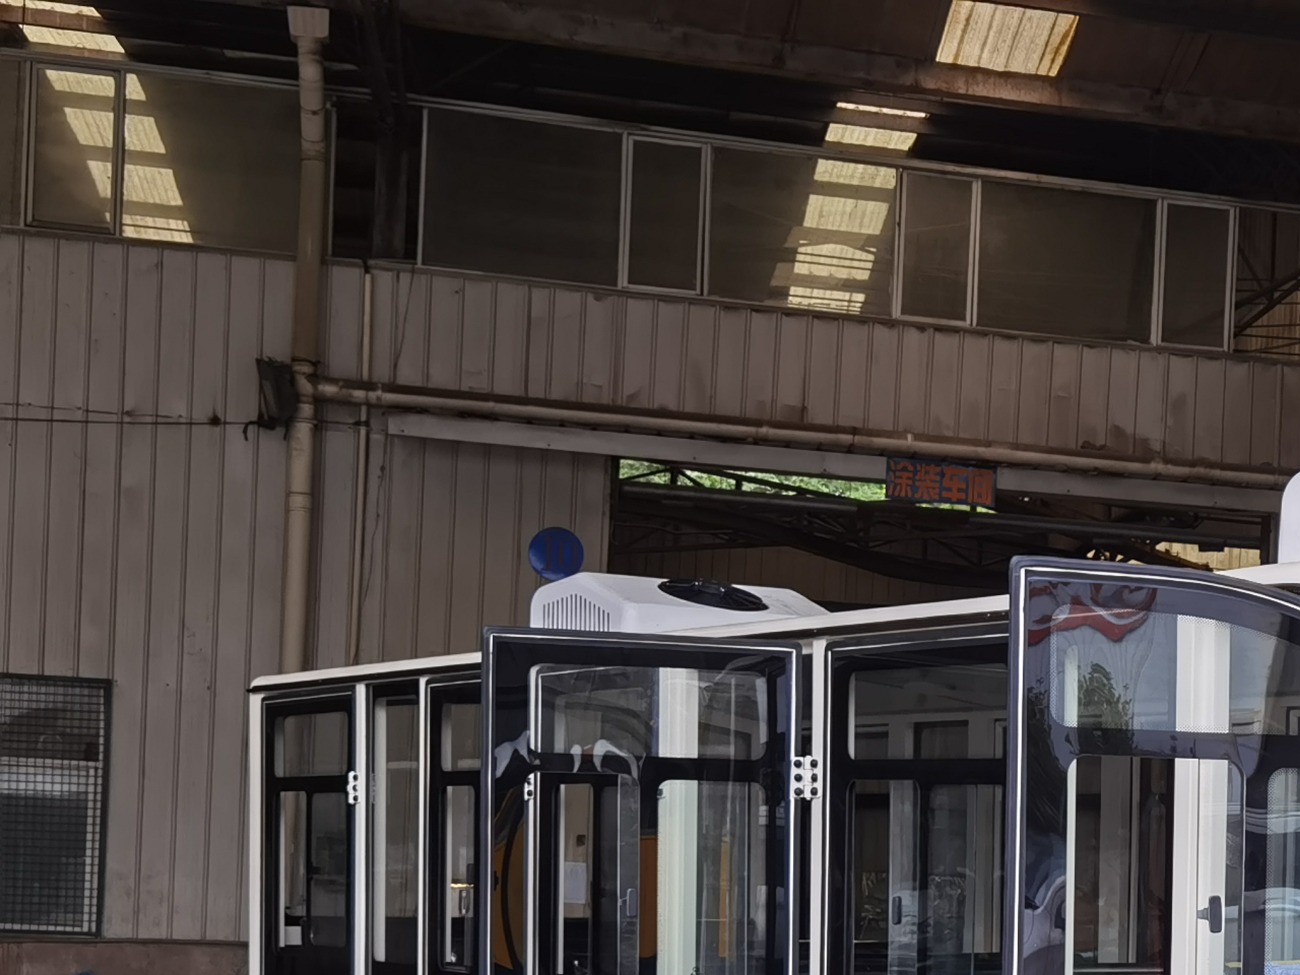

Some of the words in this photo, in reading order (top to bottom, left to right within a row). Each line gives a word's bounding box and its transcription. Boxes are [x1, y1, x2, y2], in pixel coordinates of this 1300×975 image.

[889, 460, 993, 505] 涂装车间
[541, 535, 579, 572] 10
